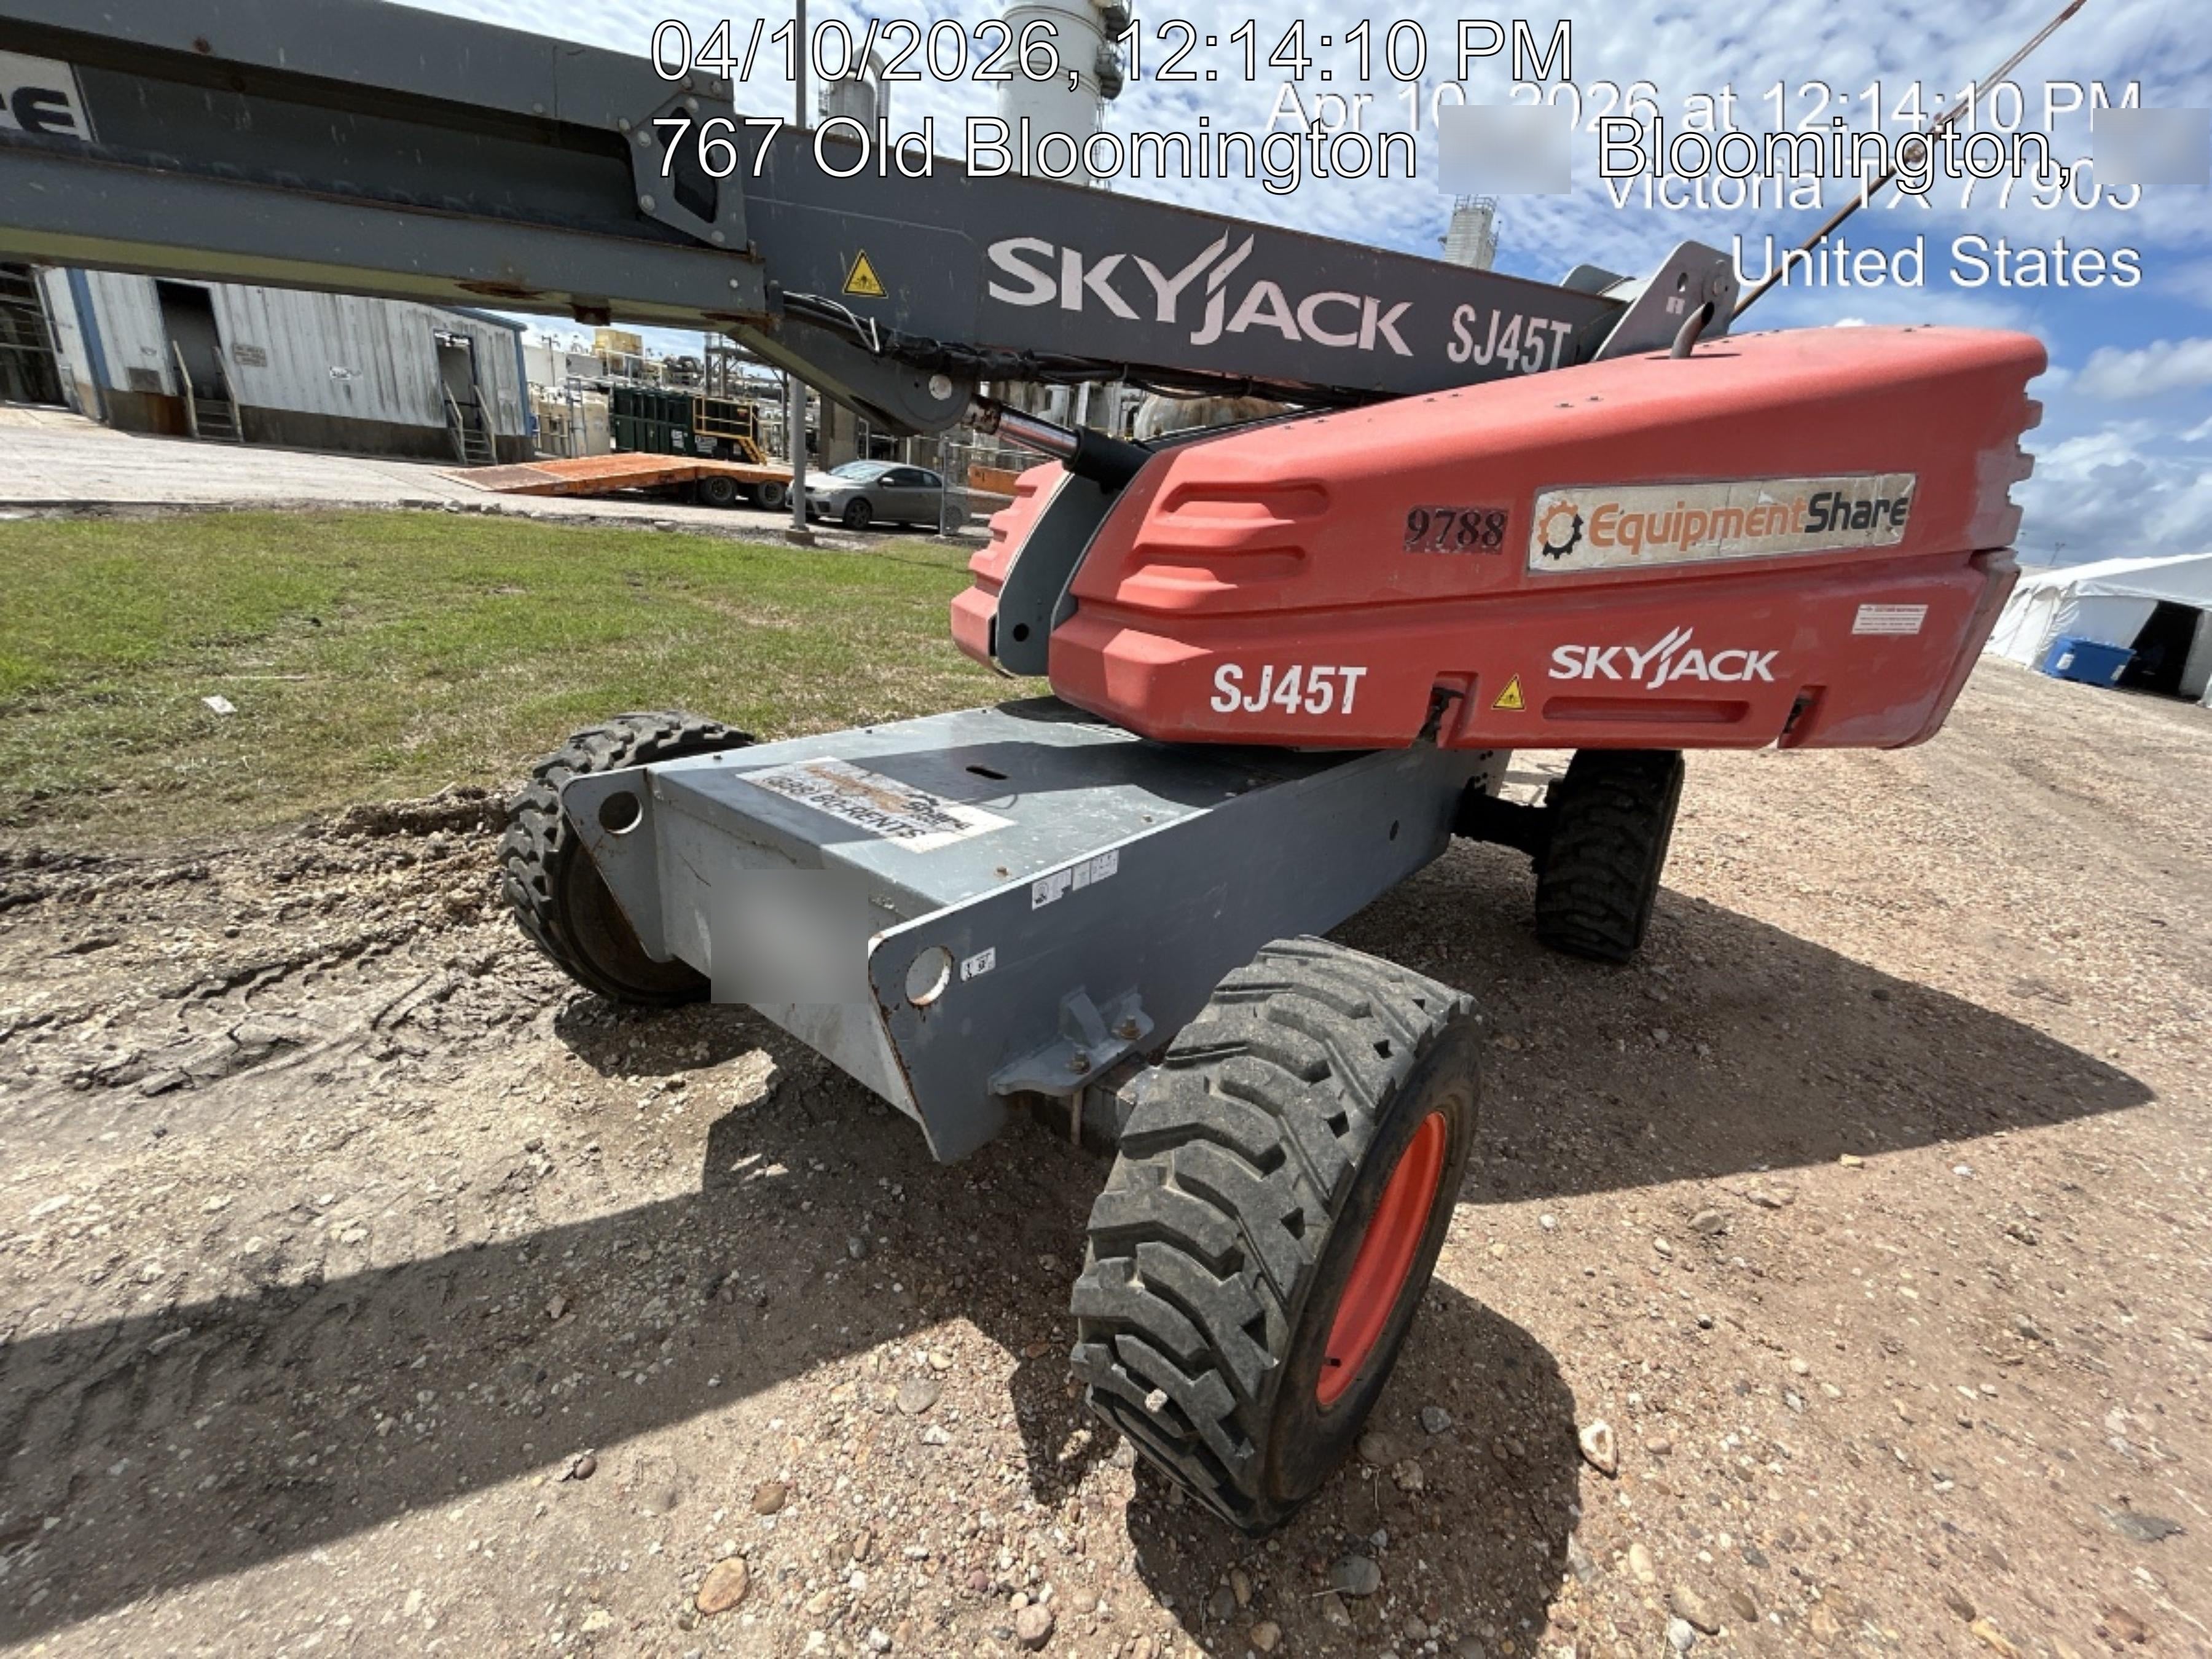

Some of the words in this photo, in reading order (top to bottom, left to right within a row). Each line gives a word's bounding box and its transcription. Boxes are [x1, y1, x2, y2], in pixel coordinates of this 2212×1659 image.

[987, 229, 1414, 358] SKYJACK
[1446, 304, 1572, 373] SJ45T
[1405, 506, 1507, 549] 9788
[1588, 490, 1909, 555] EquipmentShare
[1548, 626, 1780, 689] SKYJACK
[1209, 662, 1367, 717] SJ45T
